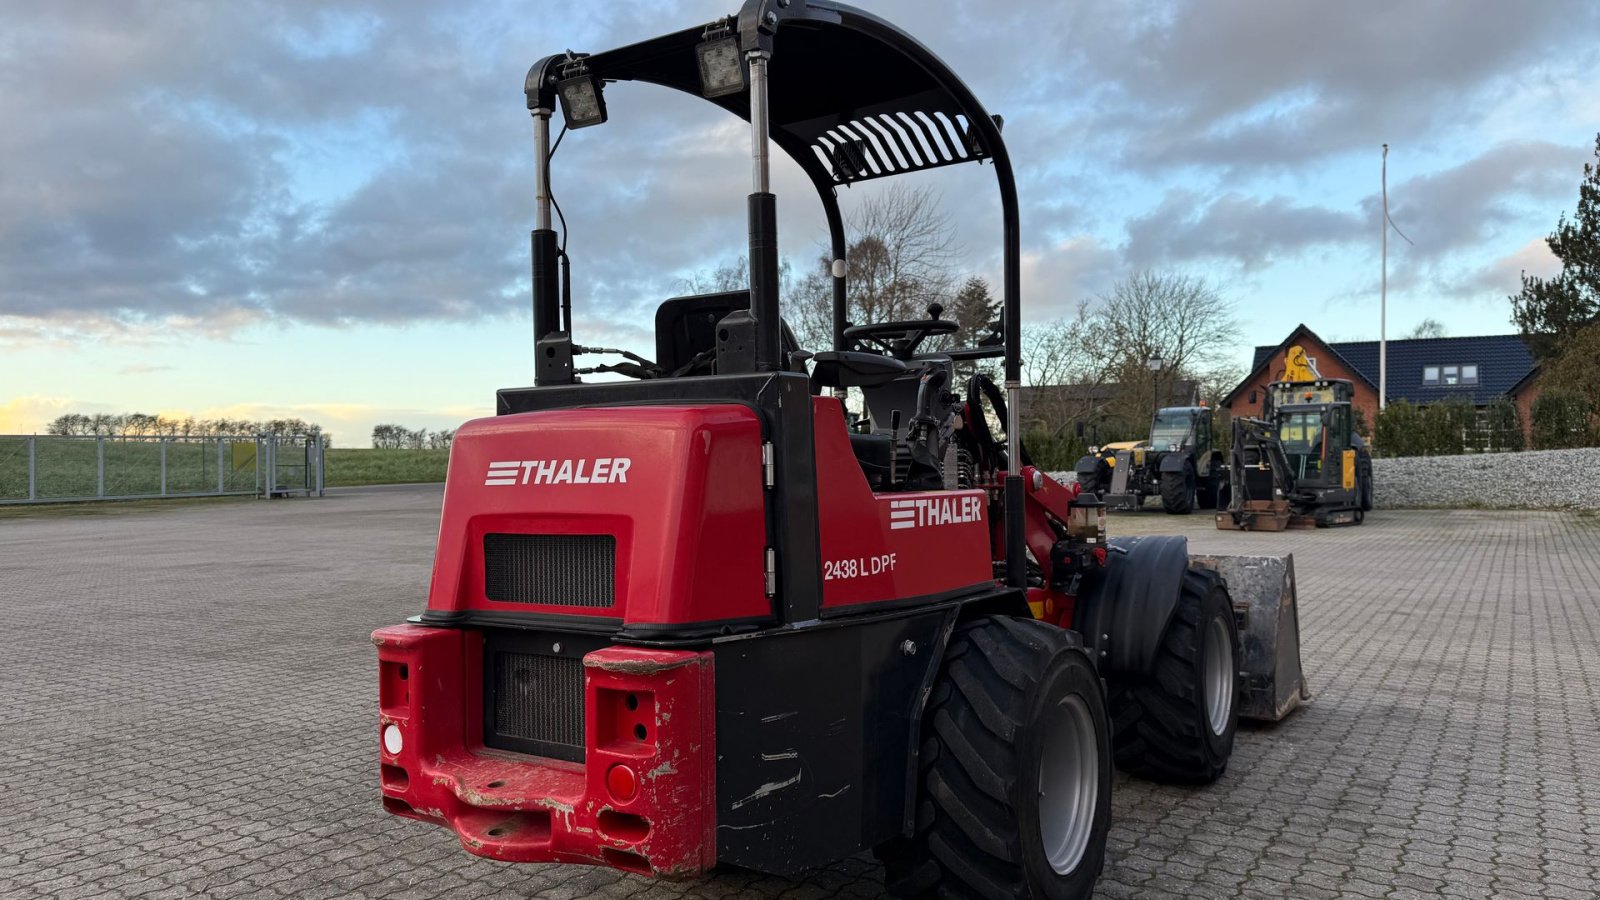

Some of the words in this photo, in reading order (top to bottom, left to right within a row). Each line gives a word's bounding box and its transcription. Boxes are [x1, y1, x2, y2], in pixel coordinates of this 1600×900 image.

[519, 457, 632, 485] THALER
[915, 496, 982, 527] THALER
[824, 559, 858, 580] 2438
[860, 558, 869, 577] L
[871, 552, 897, 575] DPF
